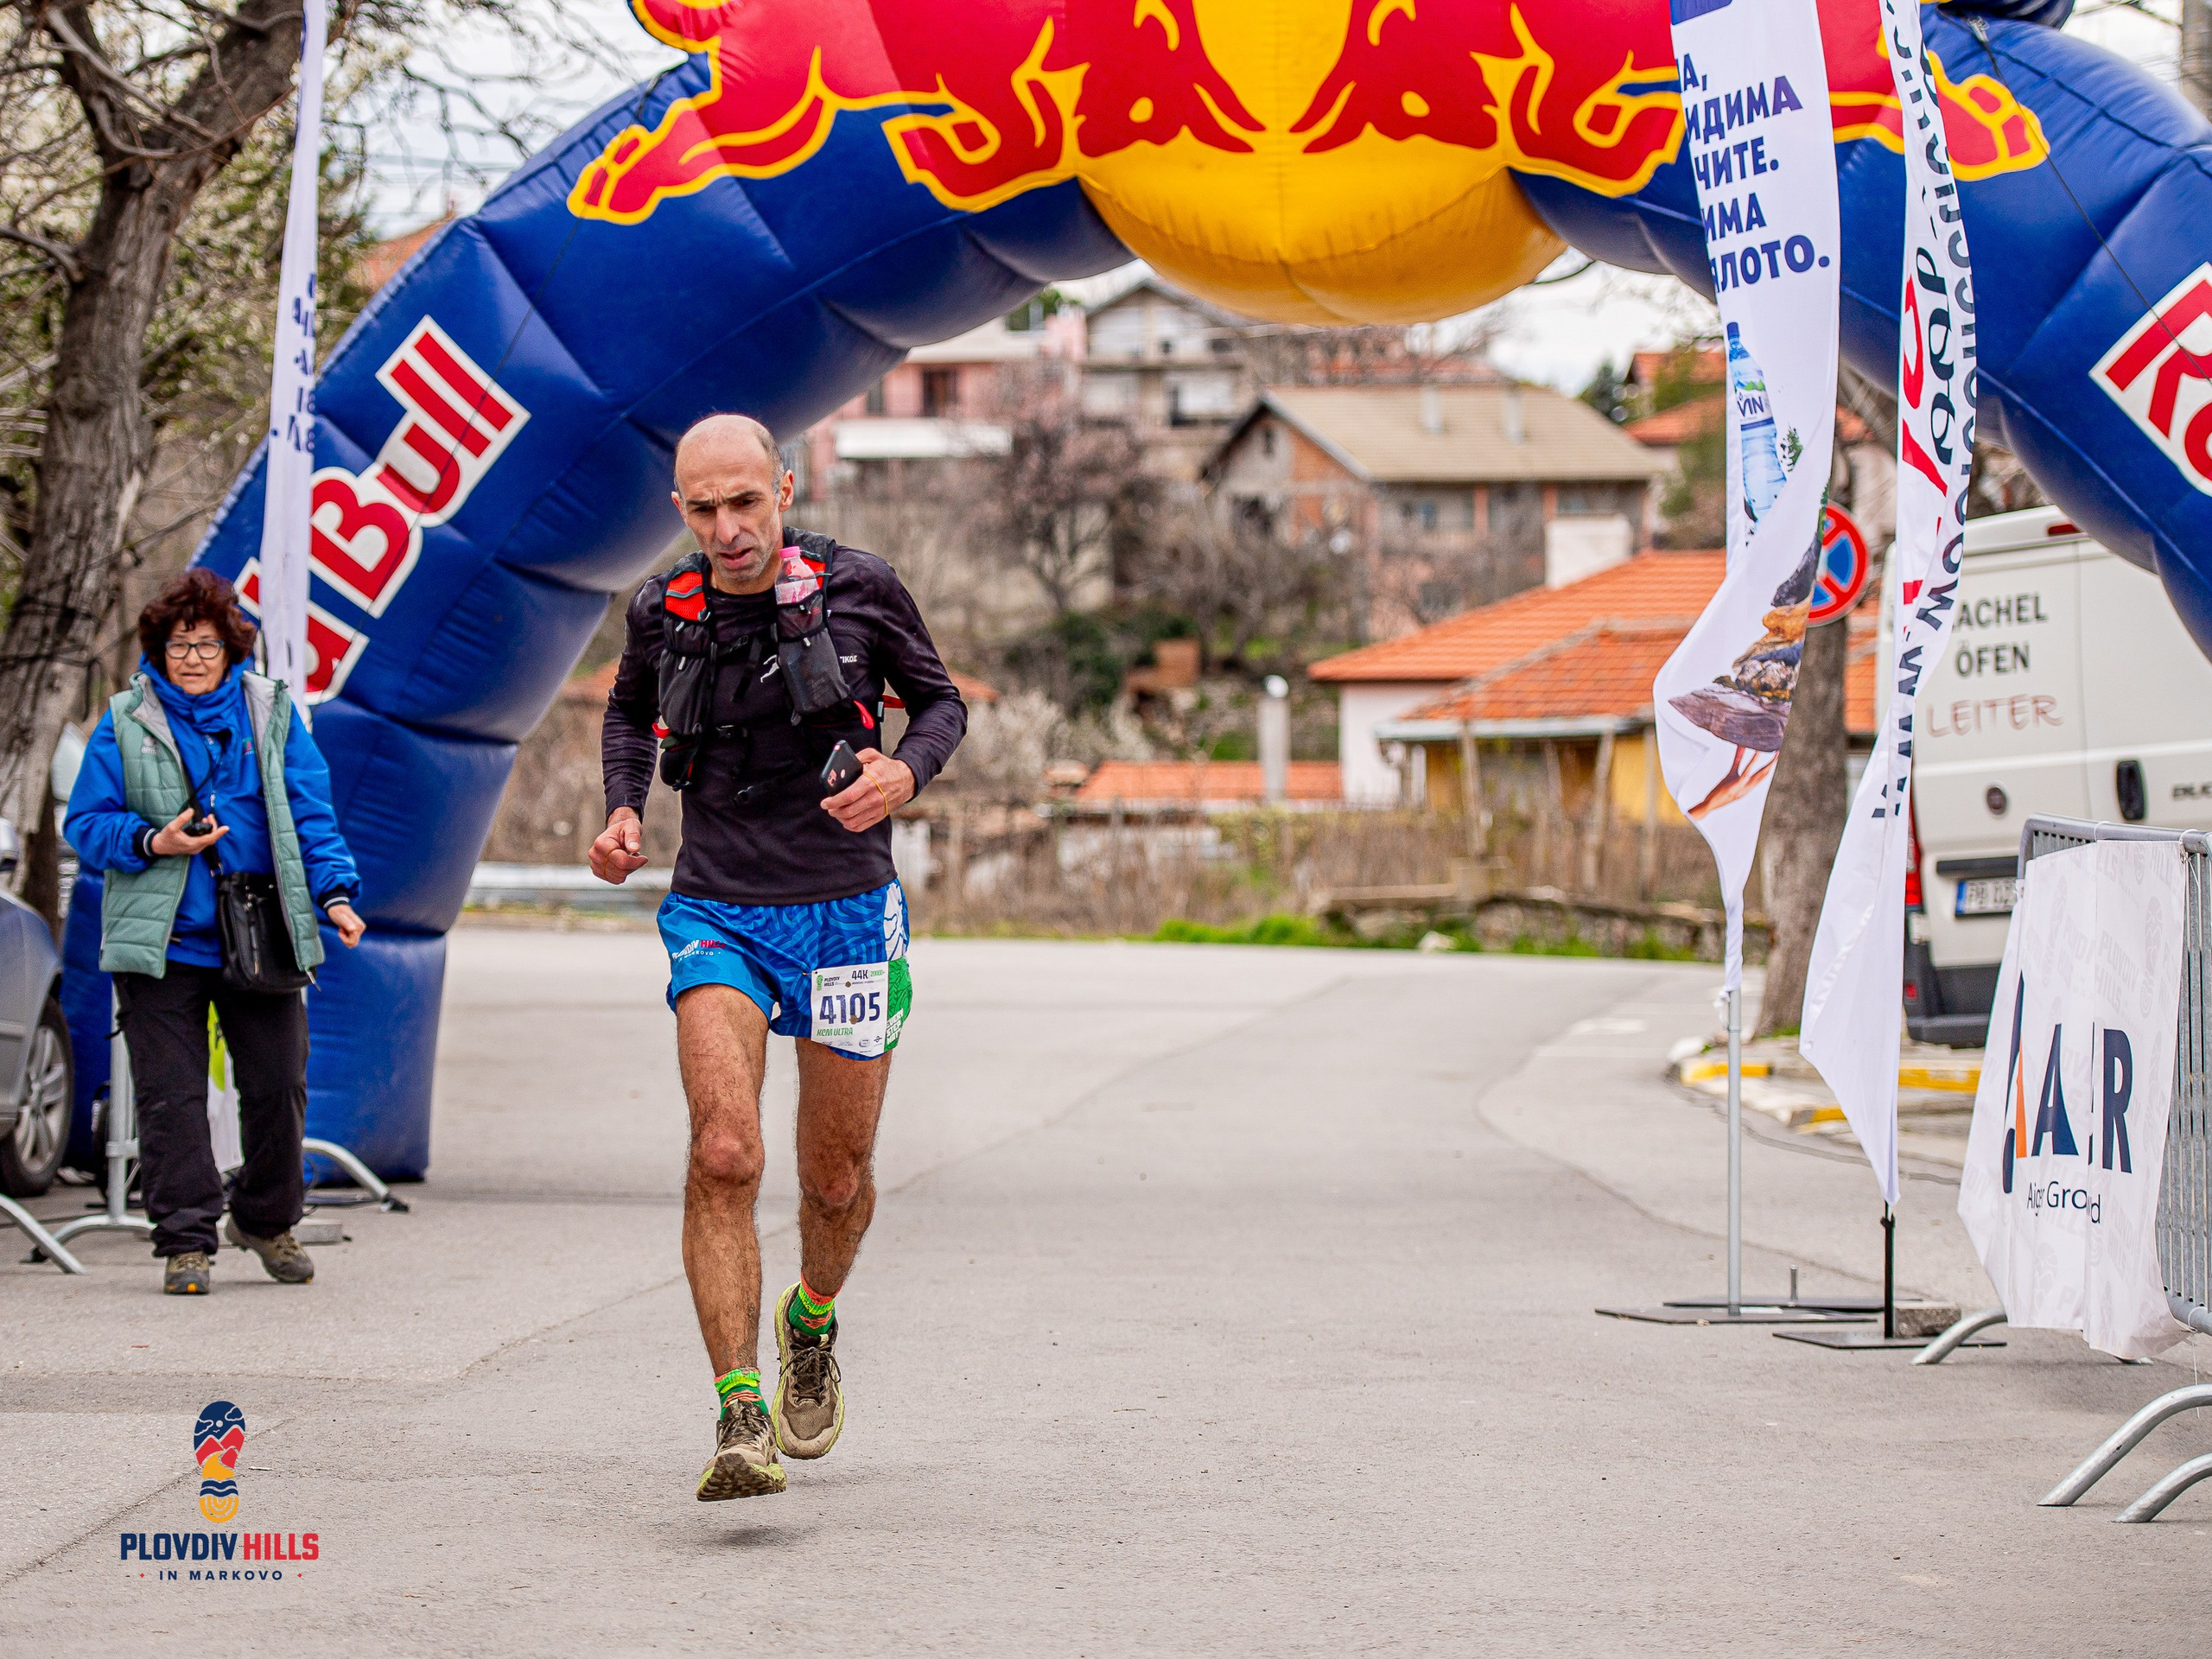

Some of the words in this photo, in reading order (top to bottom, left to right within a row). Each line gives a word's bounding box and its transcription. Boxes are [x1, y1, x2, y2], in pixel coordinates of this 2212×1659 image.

[310, 328, 517, 603] Bull
[1953, 593, 2048, 629] ACHEL
[1955, 641, 2030, 677] ÖFEN
[1926, 694, 2064, 738] LEITER
[851, 969, 869, 981] 44K
[819, 991, 880, 1025] 4105
[833, 1027, 854, 1036] ULTRA
